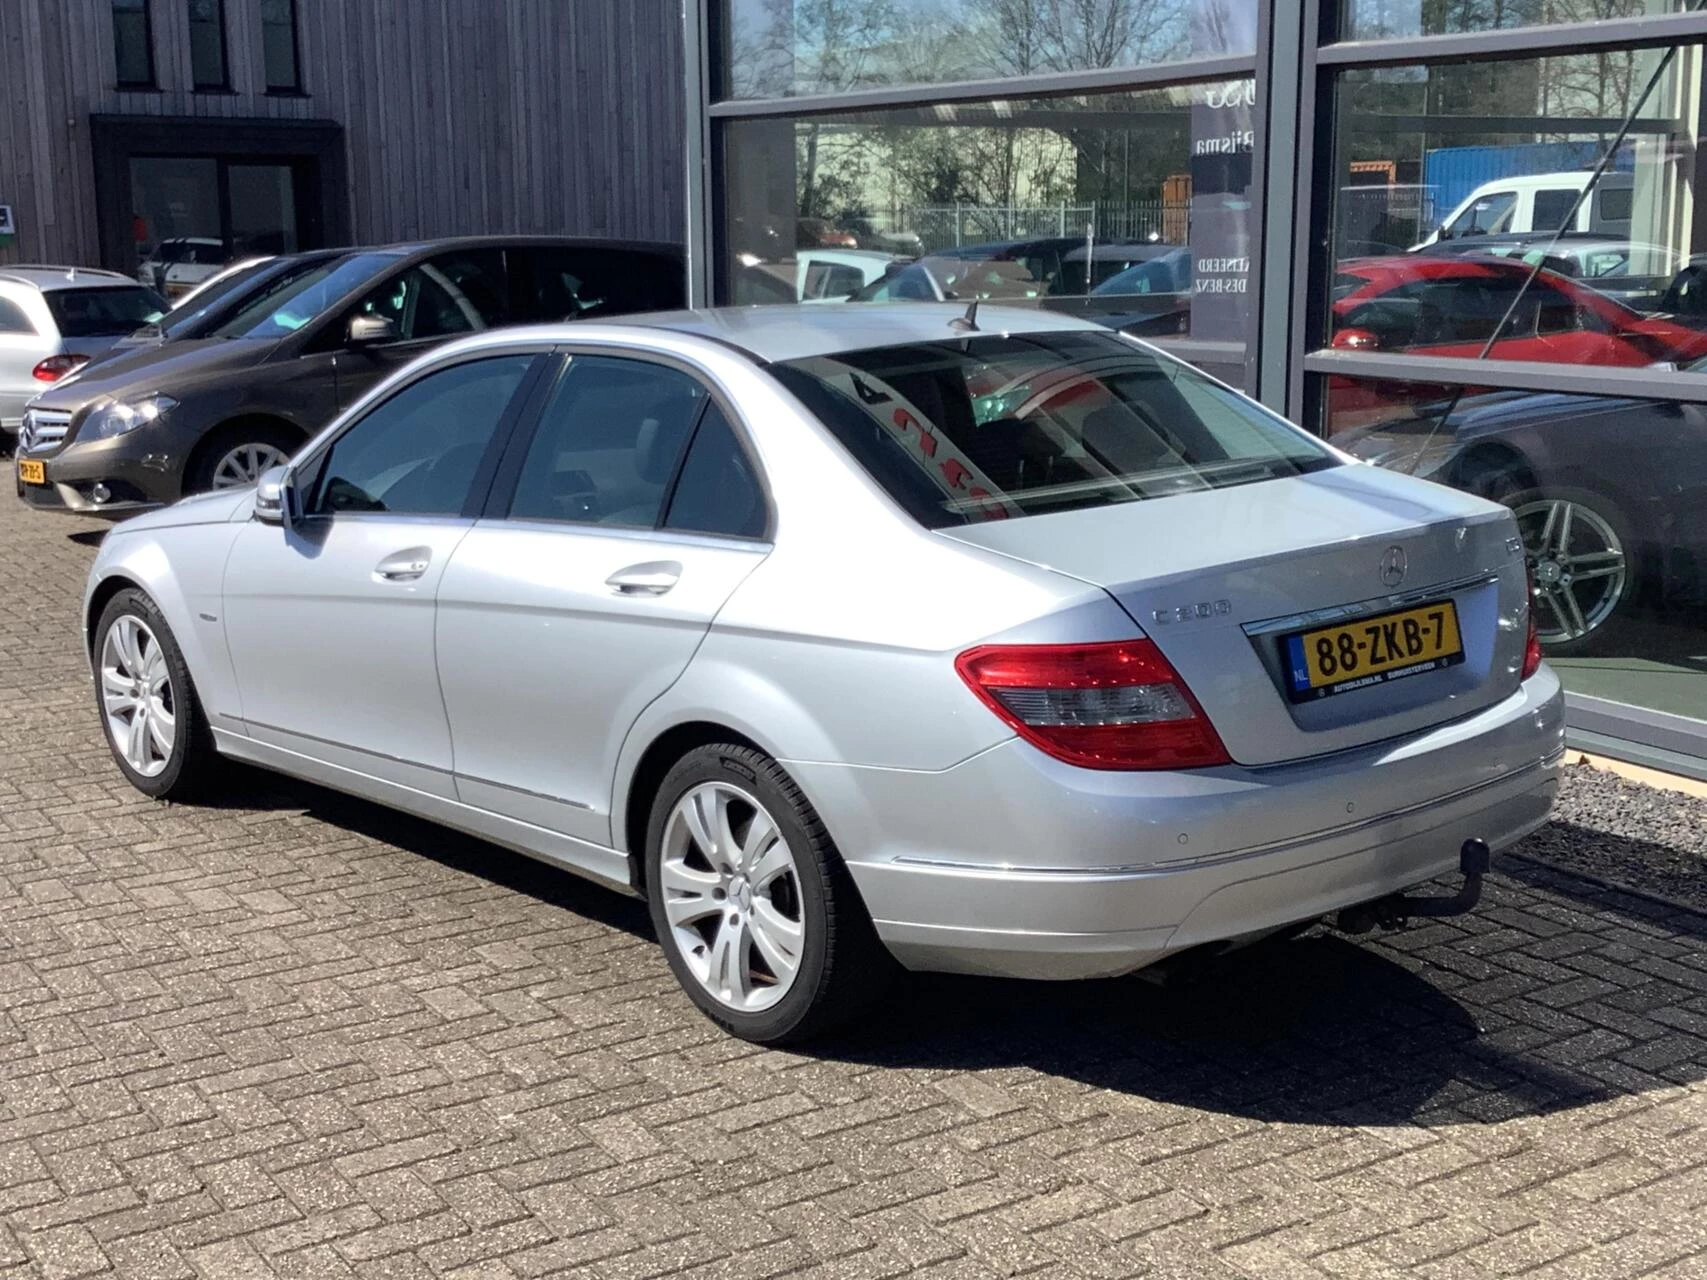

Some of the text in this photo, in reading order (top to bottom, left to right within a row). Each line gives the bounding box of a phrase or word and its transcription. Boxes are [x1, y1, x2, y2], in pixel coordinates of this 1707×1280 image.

[1152, 608, 1170, 625] C
[1316, 611, 1445, 677] 88-ZKB-7
[1293, 669, 1309, 683] NL
